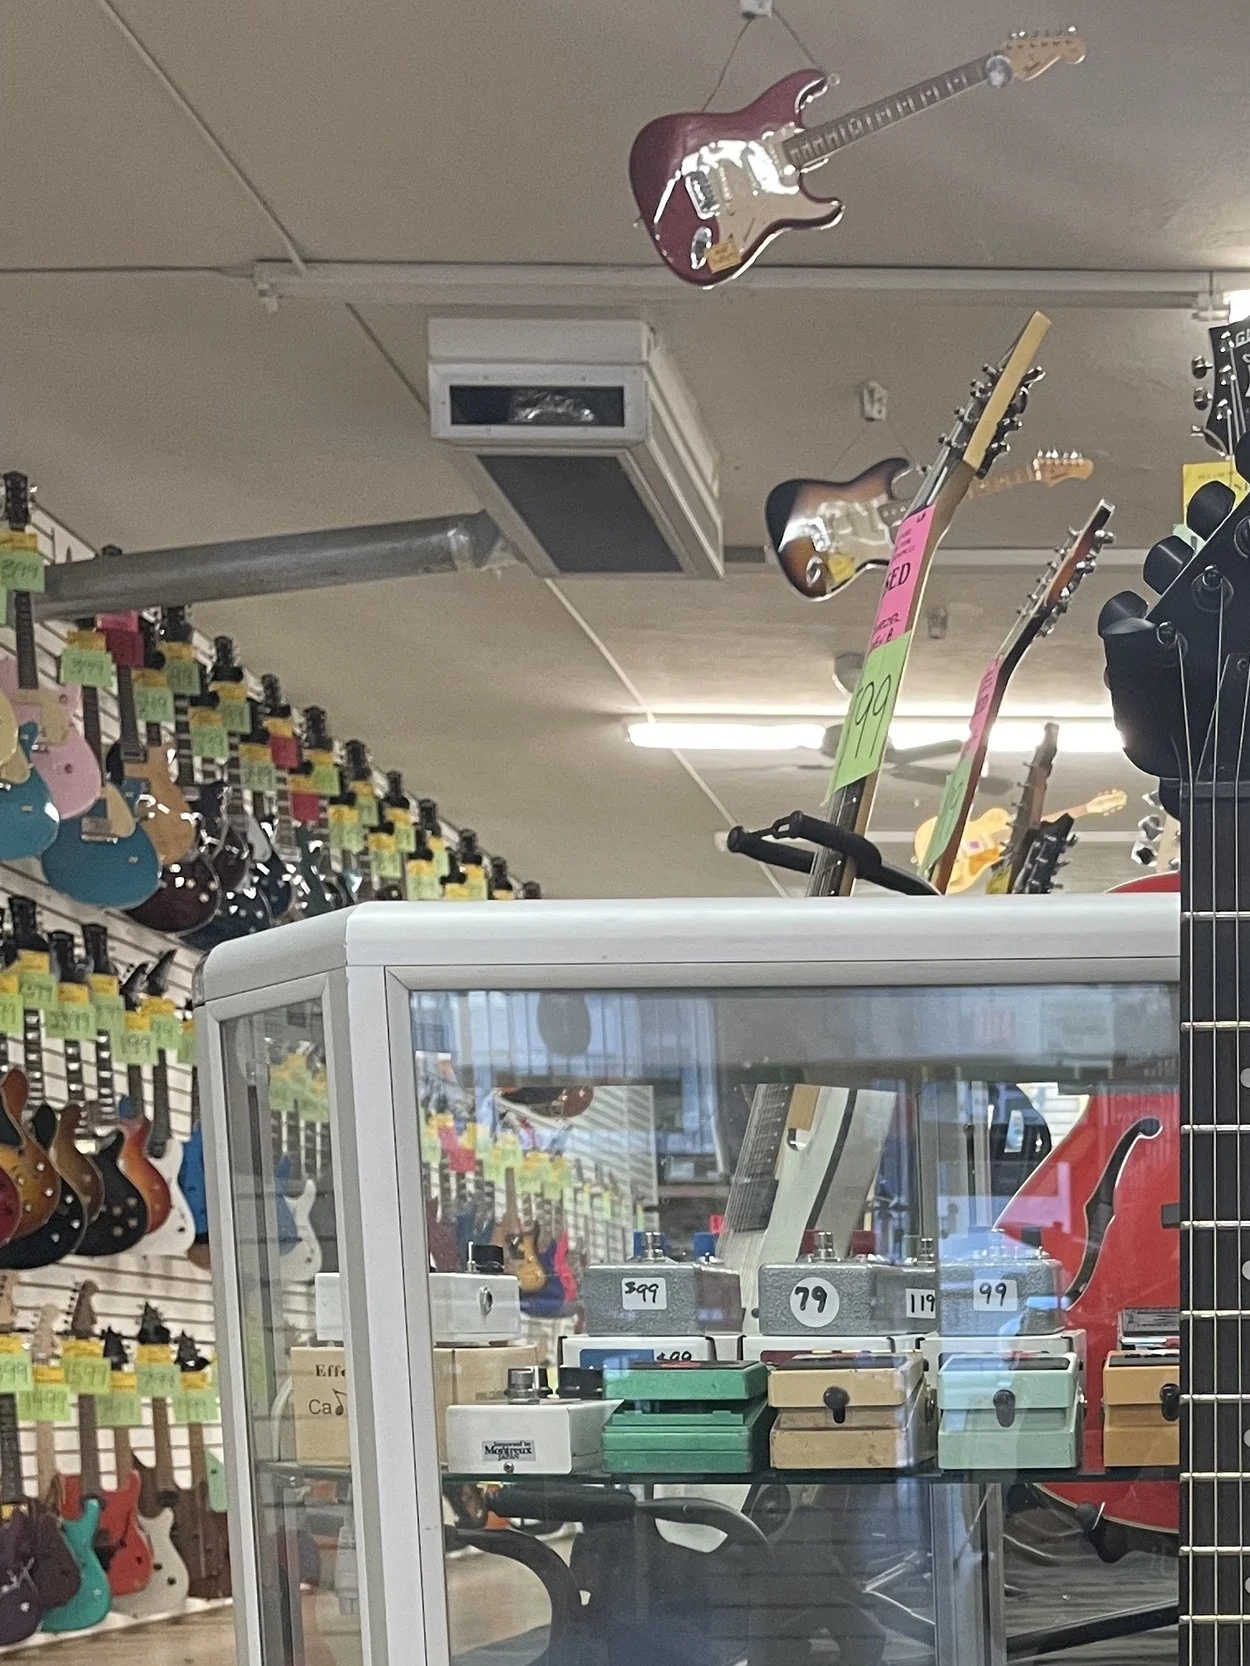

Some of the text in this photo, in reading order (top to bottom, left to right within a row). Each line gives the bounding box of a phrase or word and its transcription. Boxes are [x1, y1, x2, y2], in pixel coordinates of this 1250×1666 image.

[795, 1285, 828, 1313] 79
[910, 1293, 935, 1313] 119
[978, 1282, 1007, 1307] 99
